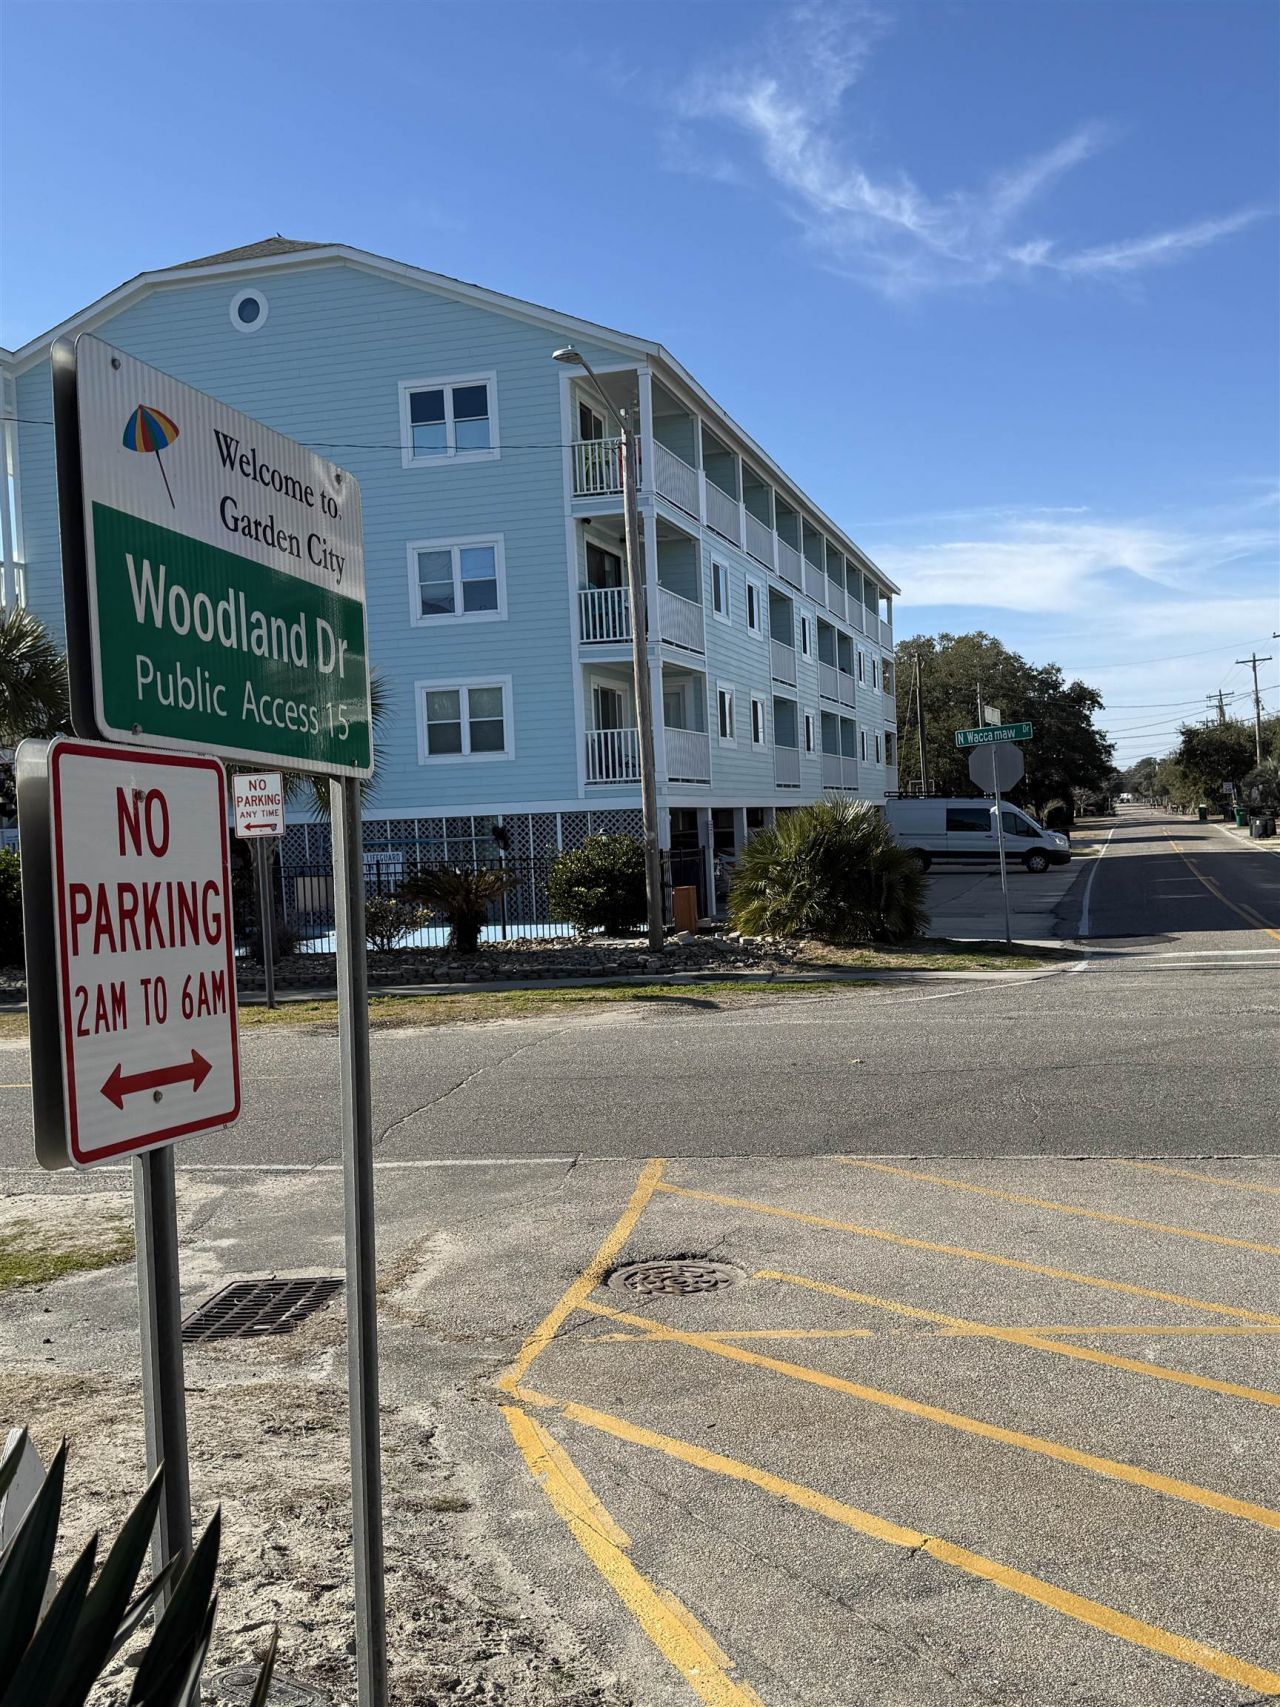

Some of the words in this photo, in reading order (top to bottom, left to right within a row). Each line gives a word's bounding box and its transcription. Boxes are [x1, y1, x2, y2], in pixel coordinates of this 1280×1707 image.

[213, 428, 314, 508] Welcome
[219, 495, 302, 559] Garden
[307, 532, 346, 585] City
[125, 552, 309, 669] Woodland
[316, 617, 349, 679] Dr
[135, 654, 227, 718] Public
[242, 681, 320, 735] Access
[325, 702, 350, 741] 15
[957, 732, 964, 745] N
[966, 729, 1015, 743] Waccamaw
[1022, 725, 1030, 733] Dr
[236, 793, 281, 808] PARKING
[239, 811, 257, 819] ANY
[261, 809, 280, 817] TIME
[248, 779, 267, 791] NO
[116, 786, 170, 858] NO
[69, 880, 223, 957] PARKING
[74, 980, 128, 1038] 2AM
[139, 975, 169, 1026] TO
[181, 969, 228, 1020] 6AM
